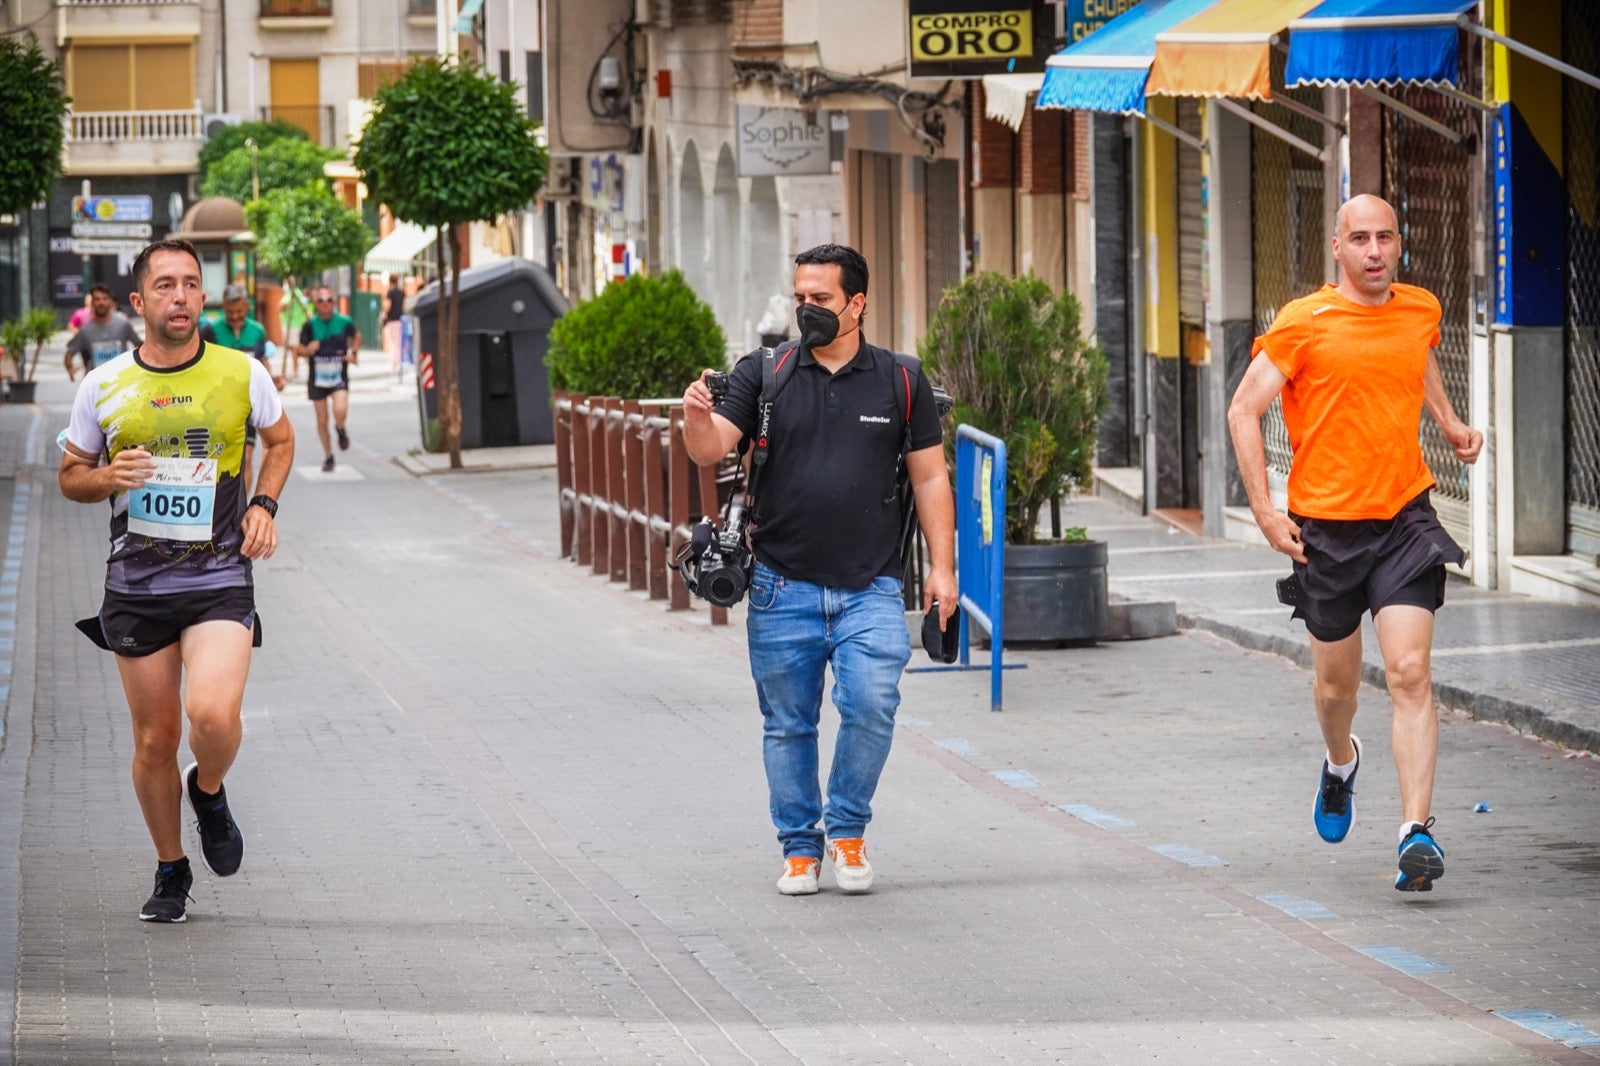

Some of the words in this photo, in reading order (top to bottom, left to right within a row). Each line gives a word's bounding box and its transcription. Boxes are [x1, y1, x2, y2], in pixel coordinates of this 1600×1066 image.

[917, 13, 1021, 31] COMPRO
[918, 28, 1022, 57] ORO
[742, 120, 825, 148] Sophie
[156, 395, 193, 405] werun
[760, 402, 774, 437] LUMIX
[758, 438, 768, 448] G
[141, 492, 201, 518] 1050
